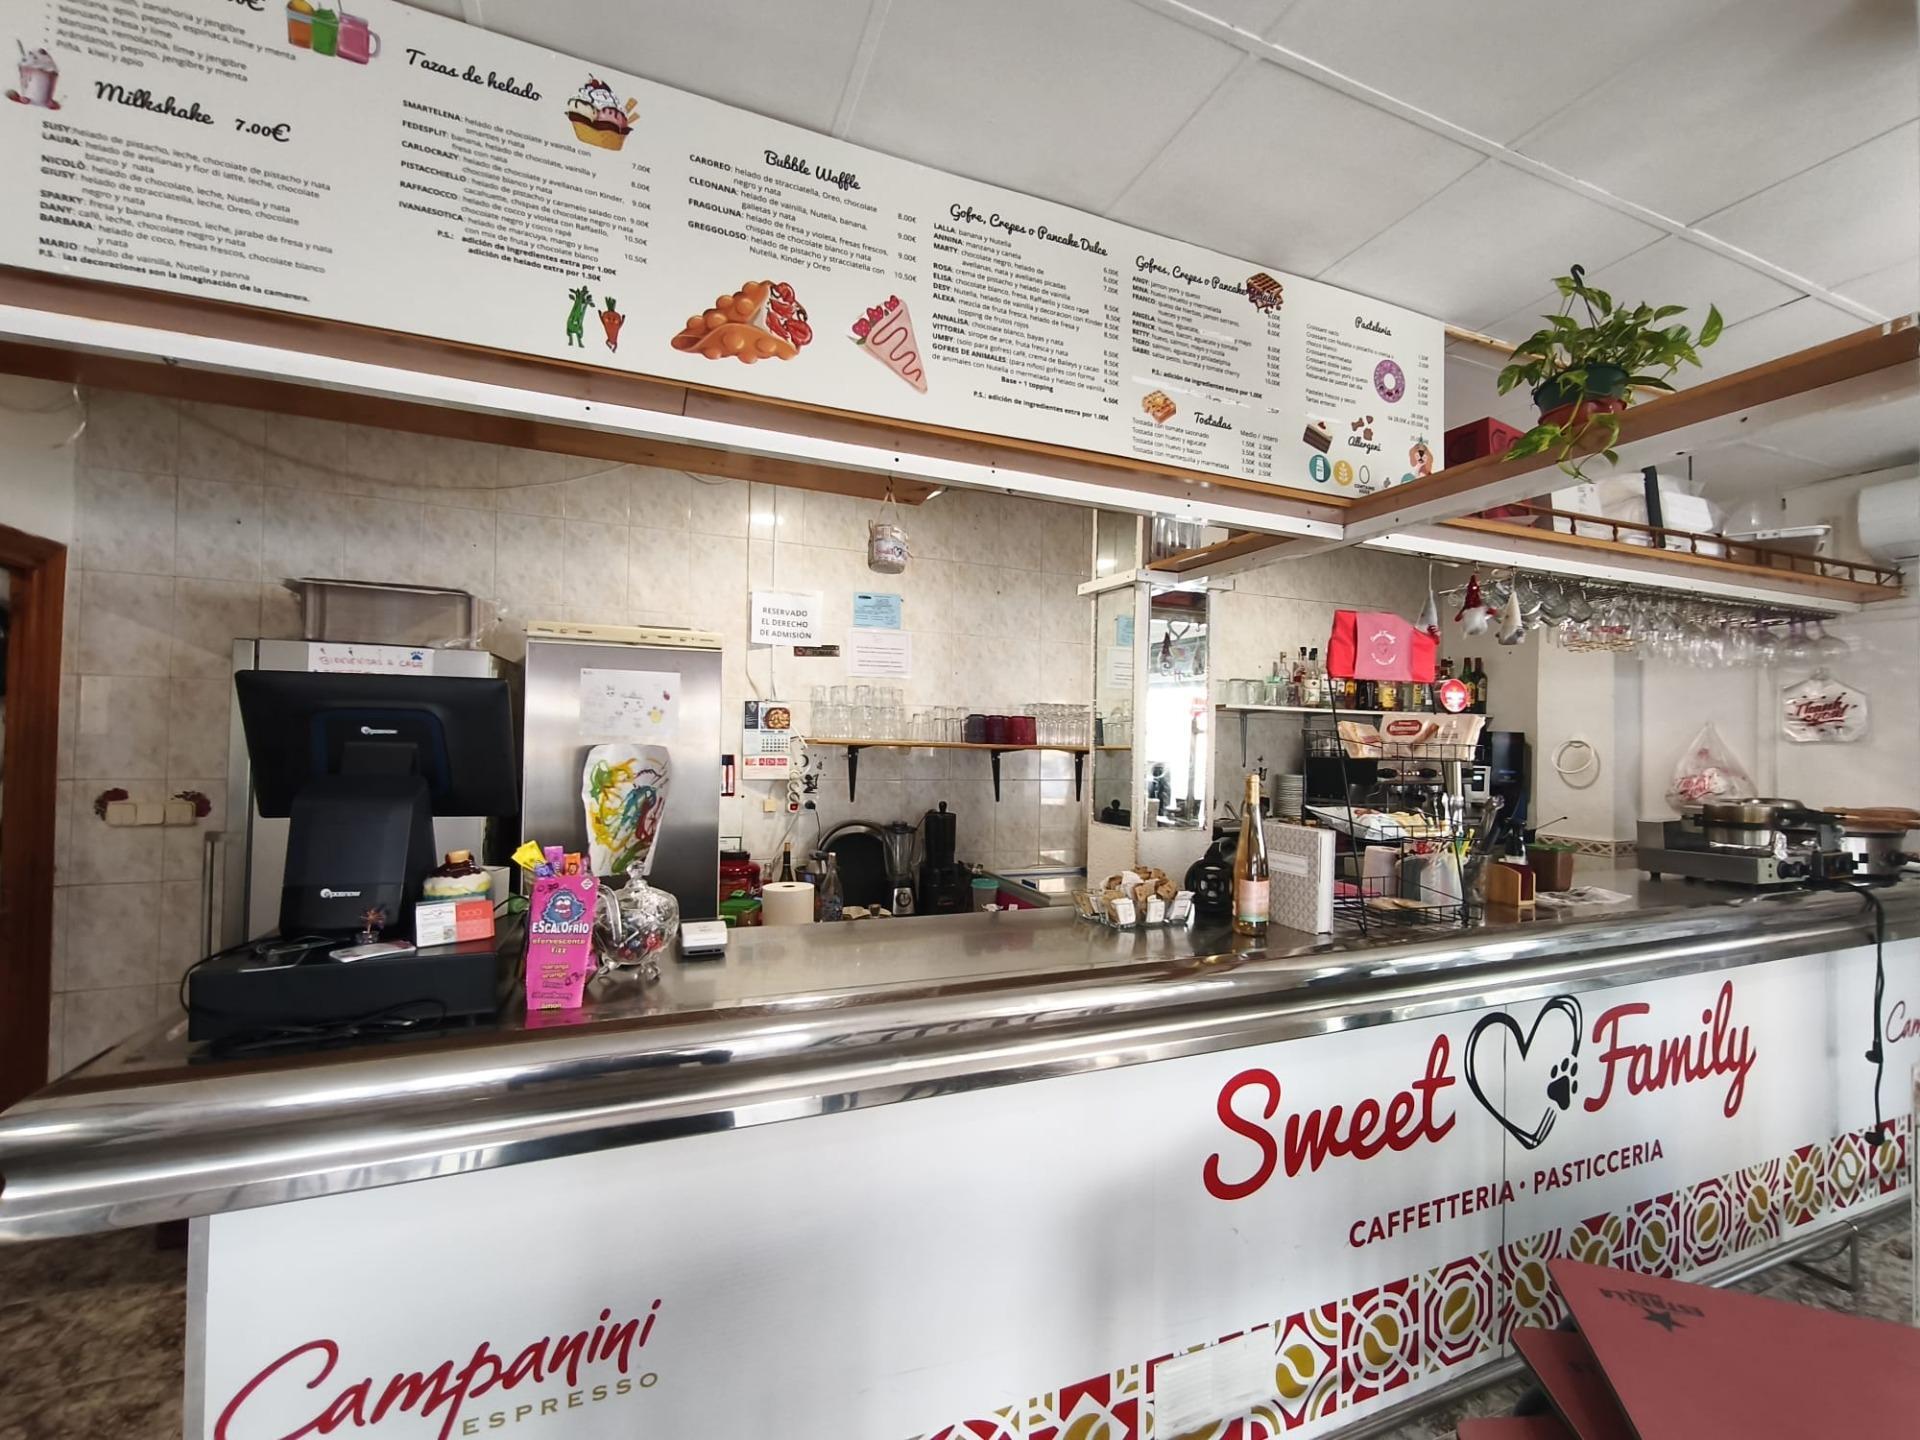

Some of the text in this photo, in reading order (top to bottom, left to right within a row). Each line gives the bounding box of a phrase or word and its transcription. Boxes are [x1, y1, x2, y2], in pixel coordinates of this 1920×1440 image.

[406, 49, 542, 101] Tazas de helado
[94, 82, 214, 124] Milkshake
[235, 119, 290, 142] 7.00€
[689, 155, 733, 172] CAROREO:
[734, 168, 761, 180] helado
[775, 180, 820, 197] stracciatella,
[822, 192, 841, 203] Oreo,
[843, 200, 877, 212] chocolate
[733, 179, 756, 189] negro
[764, 187, 781, 196] nata
[765, 150, 860, 191] Bubble Waffle
[688, 177, 738, 195] CLEONANA:
[740, 191, 767, 203] helado
[780, 203, 808, 214] vainilla,
[810, 210, 837, 223] Nutella,
[741, 203, 770, 215] galletas
[779, 213, 795, 221] nata
[688, 198, 744, 218] FRAGOLUNA:
[746, 213, 772, 225] helado
[785, 224, 804, 234] fresa
[811, 232, 837, 243] violeta,
[839, 238, 860, 248] fresas
[745, 225, 774, 237] chispas
[787, 236, 822, 249] chocolate
[824, 244, 848, 255] blanco
[855, 253, 871, 261] nata
[950, 204, 986, 224] Gofre,
[989, 214, 1026, 235] Crepes
[1037, 226, 1082, 248] Pancake
[1079, 238, 1108, 256] Dulce
[687, 221, 747, 240] GREGGOLOSO:
[750, 236, 777, 248] helado
[790, 248, 821, 259] pistacho
[829, 257, 870, 271] stracciatella
[749, 246, 778, 259] Nutella,
[780, 255, 804, 265] Kinder
[812, 262, 831, 272] Oreo
[1135, 256, 1170, 275] Gofres,
[1172, 266, 1202, 285] Crepes
[1211, 276, 1248, 295] Pancake
[1193, 412, 1232, 430] Tostadas
[761, 618, 809, 629] EL DERECHO
[762, 606, 808, 618] RESERVADO
[760, 629, 770, 637] DE
[1203, 980, 1758, 1201] Sweet Family
[1349, 1139, 1664, 1248] CAFFETTERIA PASTICCERIA
[213, 1298, 662, 1440] Campanini
[461, 1372, 659, 1436] ESPRESSO
